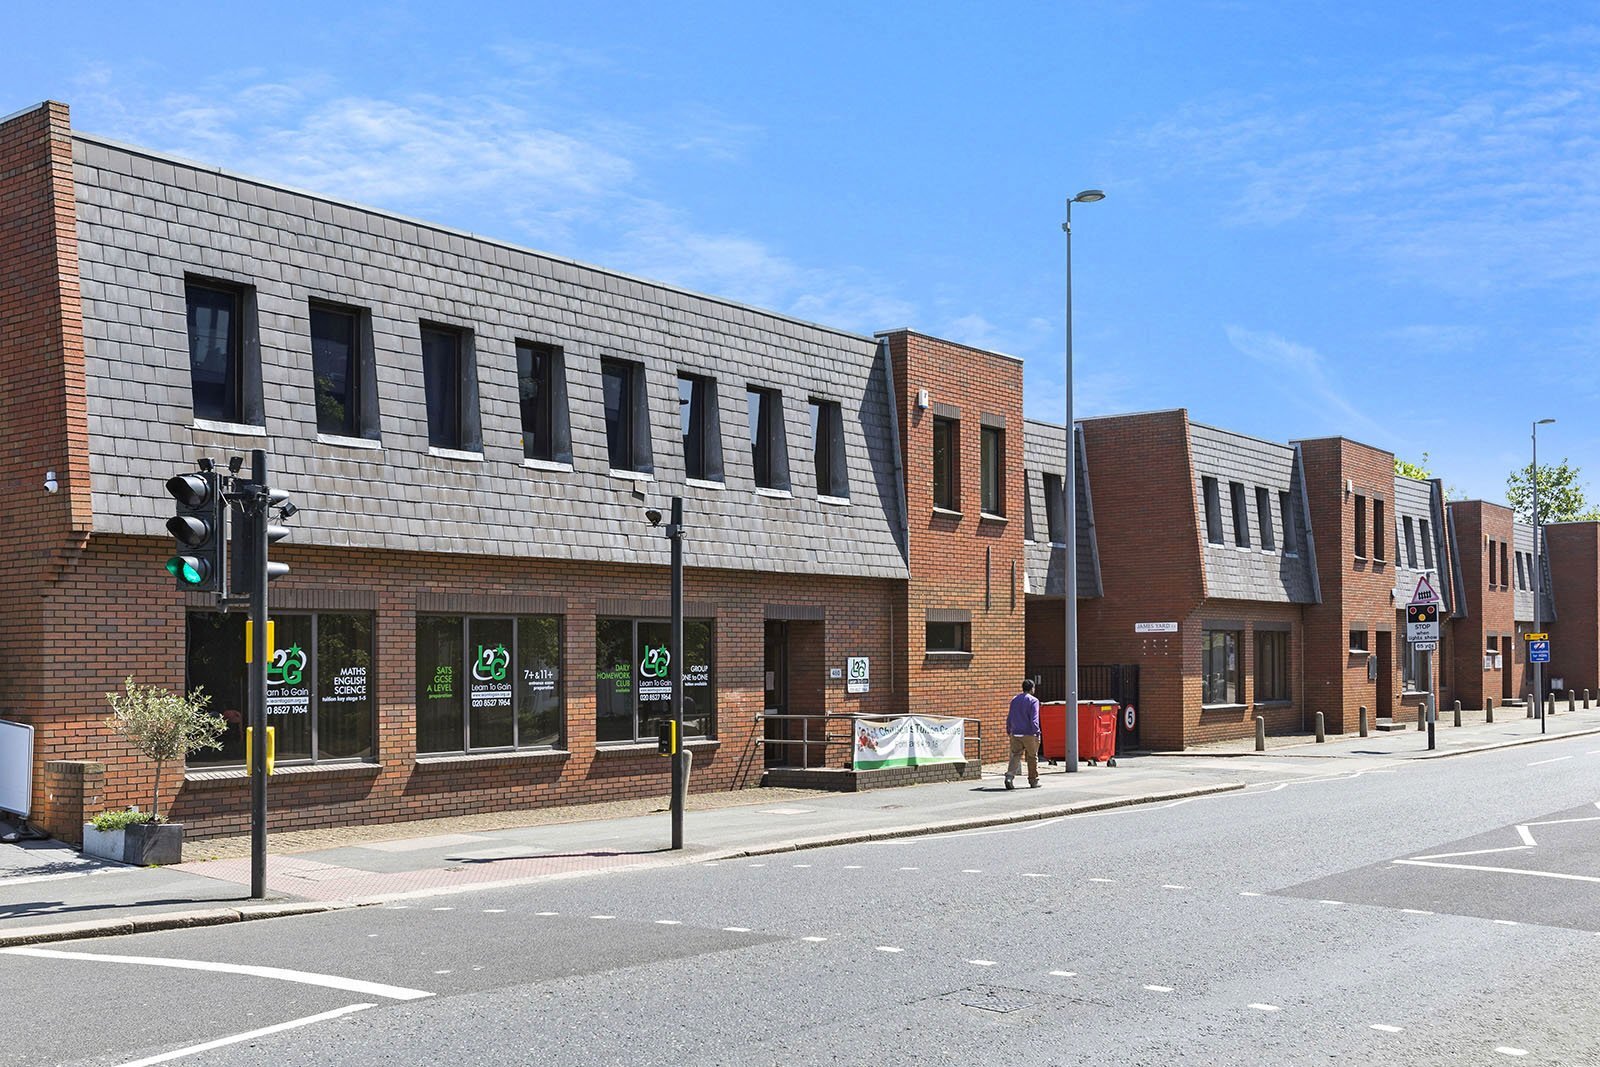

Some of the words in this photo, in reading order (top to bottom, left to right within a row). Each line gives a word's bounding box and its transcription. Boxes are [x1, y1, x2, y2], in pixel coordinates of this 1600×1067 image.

[340, 667, 366, 676] MATHS
[436, 666, 452, 674] SATS
[334, 677, 366, 685] ENGLISH
[434, 675, 452, 683] GCSE
[334, 686, 366, 695] SCIENCE
[427, 684, 432, 692] A
[434, 684, 452, 692] LEVEL
[267, 689, 279, 697] arn
[281, 688, 289, 696] To
[291, 688, 309, 696] Gain
[273, 706, 290, 714] 8527
[1127, 712, 1133, 725] 5
